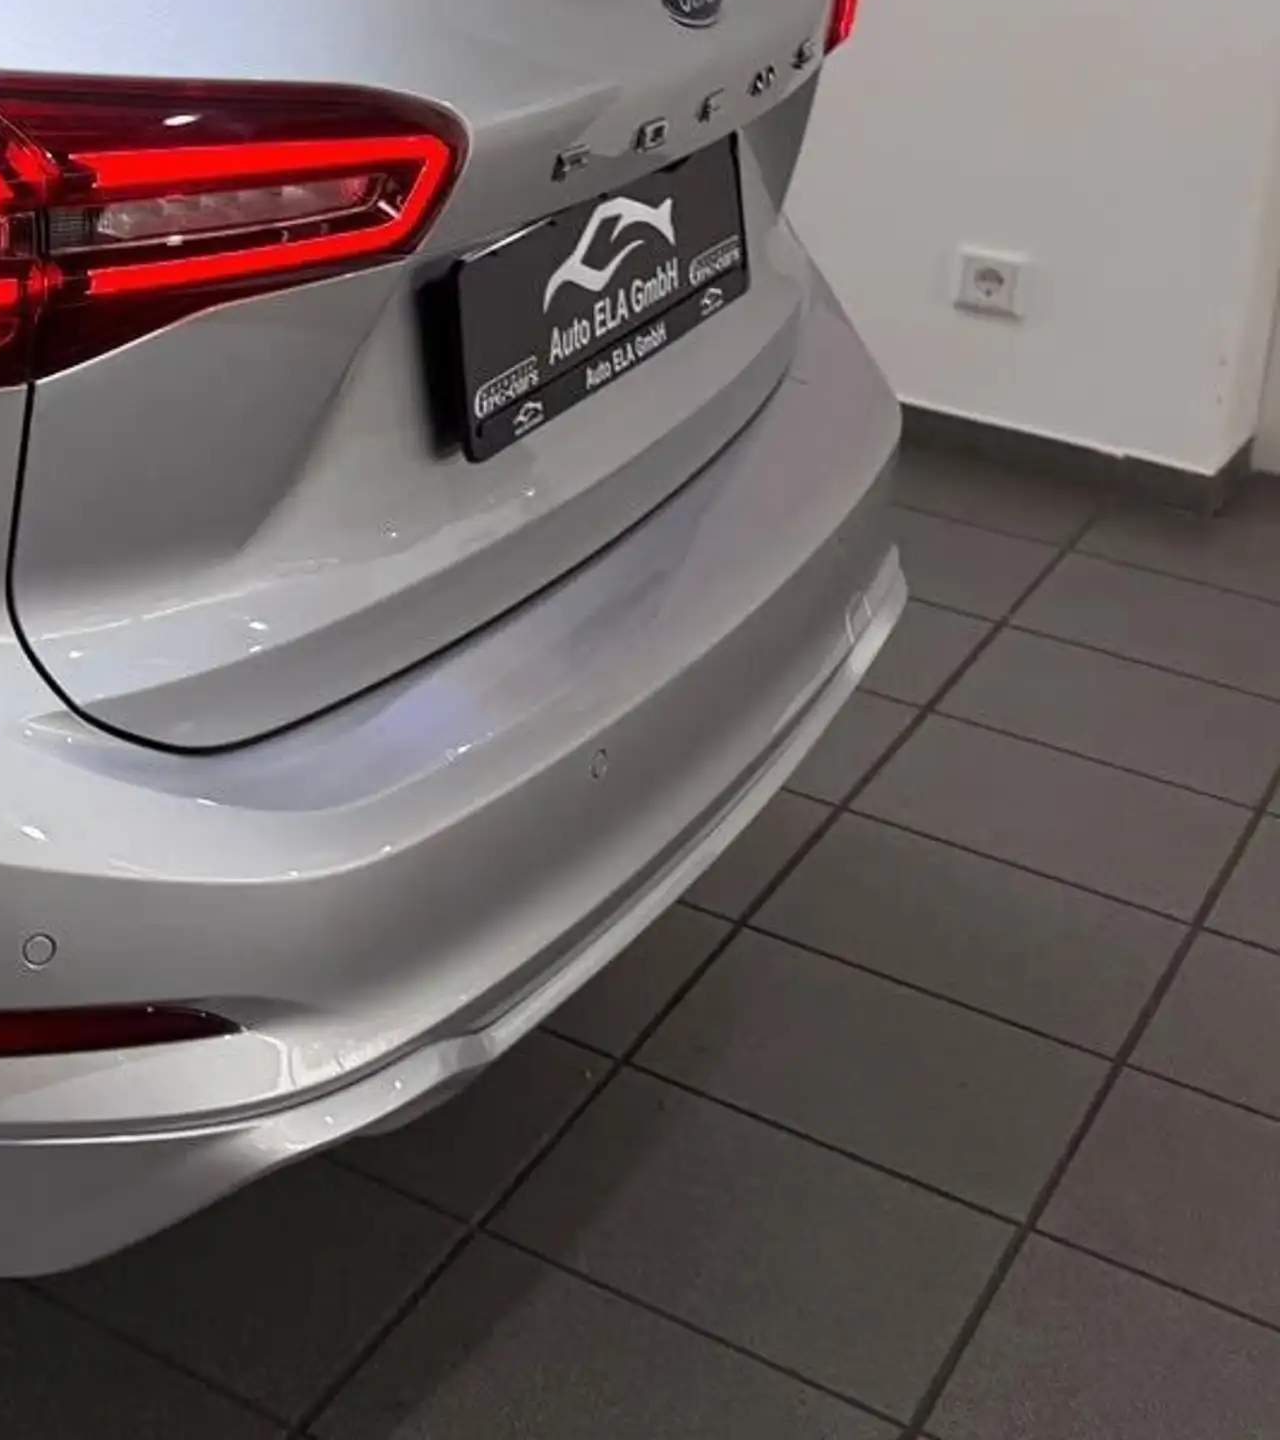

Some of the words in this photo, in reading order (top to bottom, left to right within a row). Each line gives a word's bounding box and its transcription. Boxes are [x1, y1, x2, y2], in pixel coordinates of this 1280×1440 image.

[548, 318, 591, 365] Auto
[593, 288, 629, 337] ELA
[630, 257, 679, 314] GmbH
[585, 363, 612, 390] Auto
[612, 342, 636, 372] ELA
[635, 320, 667, 357] GmbH
